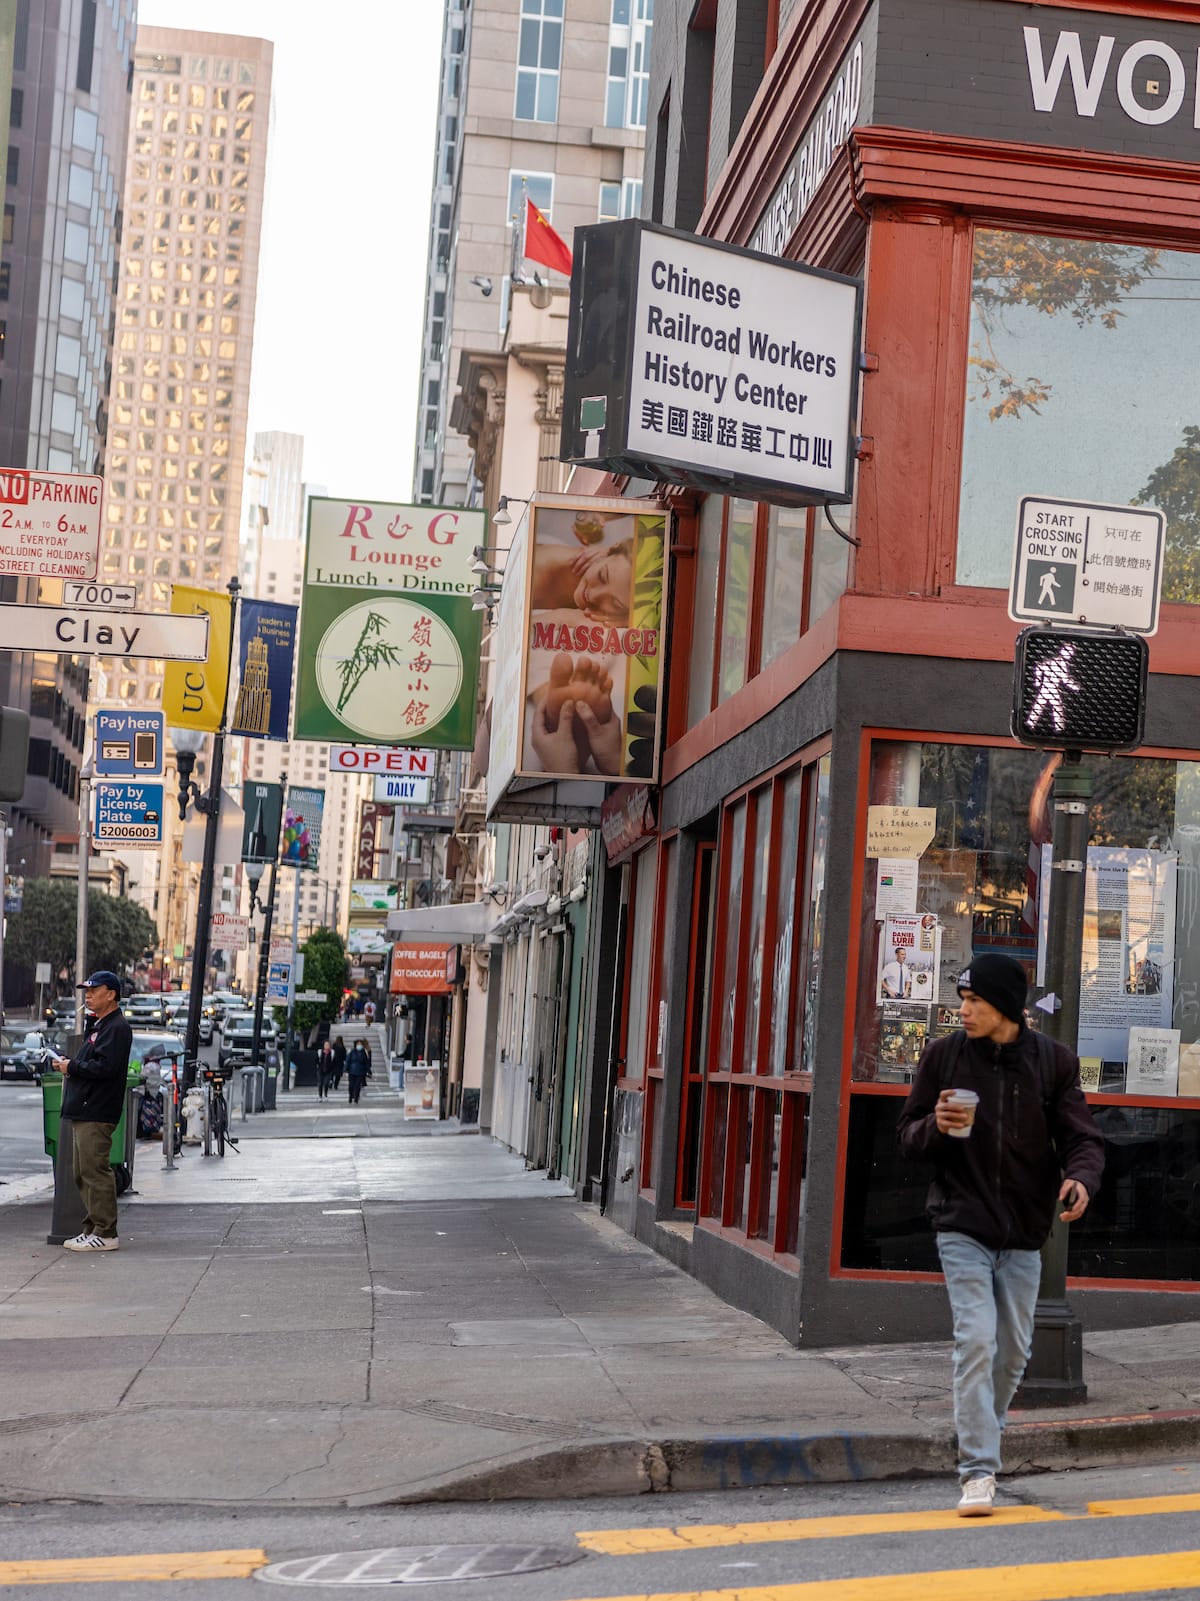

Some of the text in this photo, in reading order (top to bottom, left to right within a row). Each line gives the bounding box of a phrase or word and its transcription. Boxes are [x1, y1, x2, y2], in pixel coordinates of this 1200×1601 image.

[796, 41, 863, 223] RAILROAD
[651, 260, 741, 309] Chinese
[647, 305, 837, 378] Railroad Workers
[644, 351, 808, 415] History Center
[641, 399, 832, 469] 美國鐵路華工中心
[0, 473, 98, 505] NO PARKING
[42, 521, 51, 529] TO
[339, 504, 459, 546] R & G
[1036, 512, 1074, 527] START
[20, 534, 68, 546] EVERYDAY
[1025, 527, 1082, 544] CROSSING
[1104, 527, 1142, 542] 只可在
[0, 545, 91, 562] NCLUDING HOLIDAYS
[350, 545, 442, 571] Lounge
[1028, 543, 1077, 559] ONLY ON
[0, 559, 85, 576] STREET CLEANING
[315, 567, 475, 593] Lunch Dinner
[72, 585, 113, 604] 700
[56, 617, 140, 652] Clay
[533, 621, 658, 657] MASSAGE
[401, 615, 432, 727] 嶺南小館
[182, 672, 205, 713] UC
[100, 716, 160, 731] Pay here
[339, 751, 427, 772] OPEN
[100, 786, 144, 801] Pay by
[387, 781, 415, 798] DAILY
[100, 798, 147, 810] License
[100, 810, 132, 822] Plate
[101, 826, 156, 838] 52006003
[406, 969, 445, 978] CHOCOLATE
